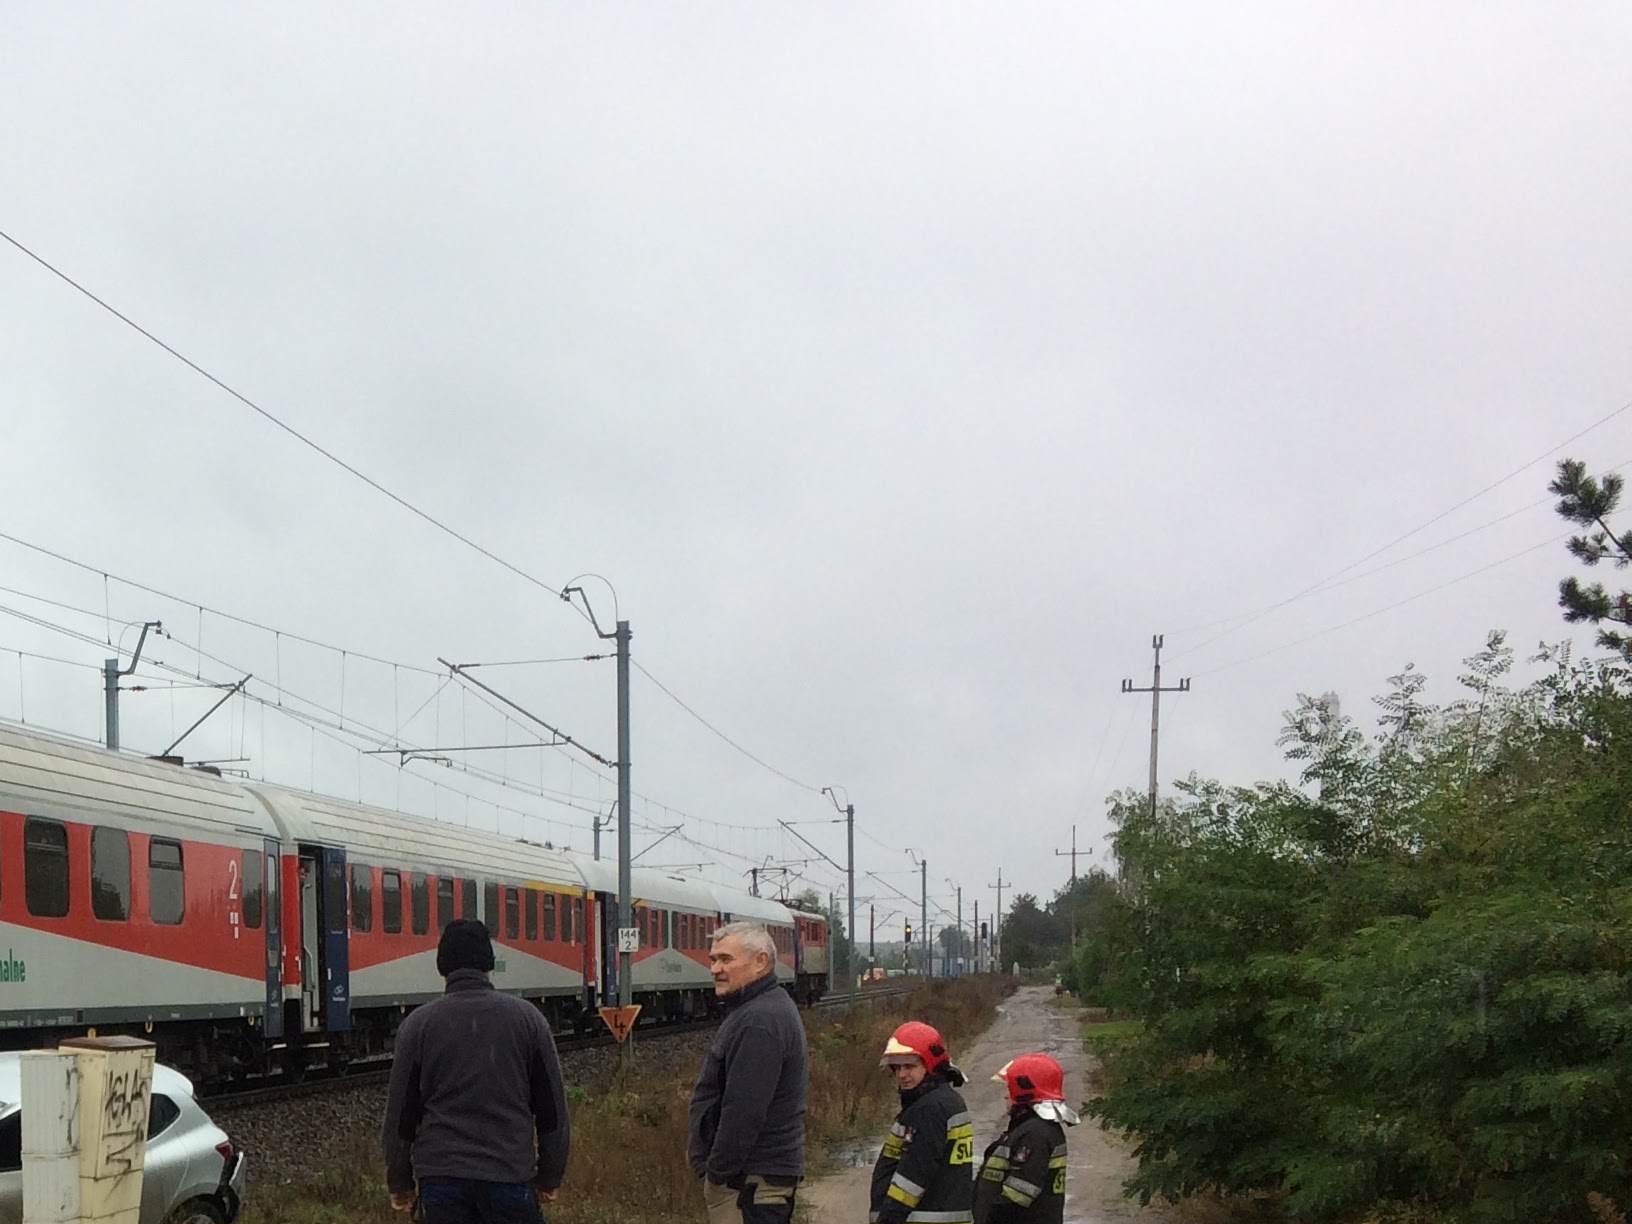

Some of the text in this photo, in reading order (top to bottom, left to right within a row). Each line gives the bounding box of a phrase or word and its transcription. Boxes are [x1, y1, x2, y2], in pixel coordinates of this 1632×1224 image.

[228, 859, 238, 900] 2
[620, 929, 637, 940] 144
[625, 940, 632, 951] 2
